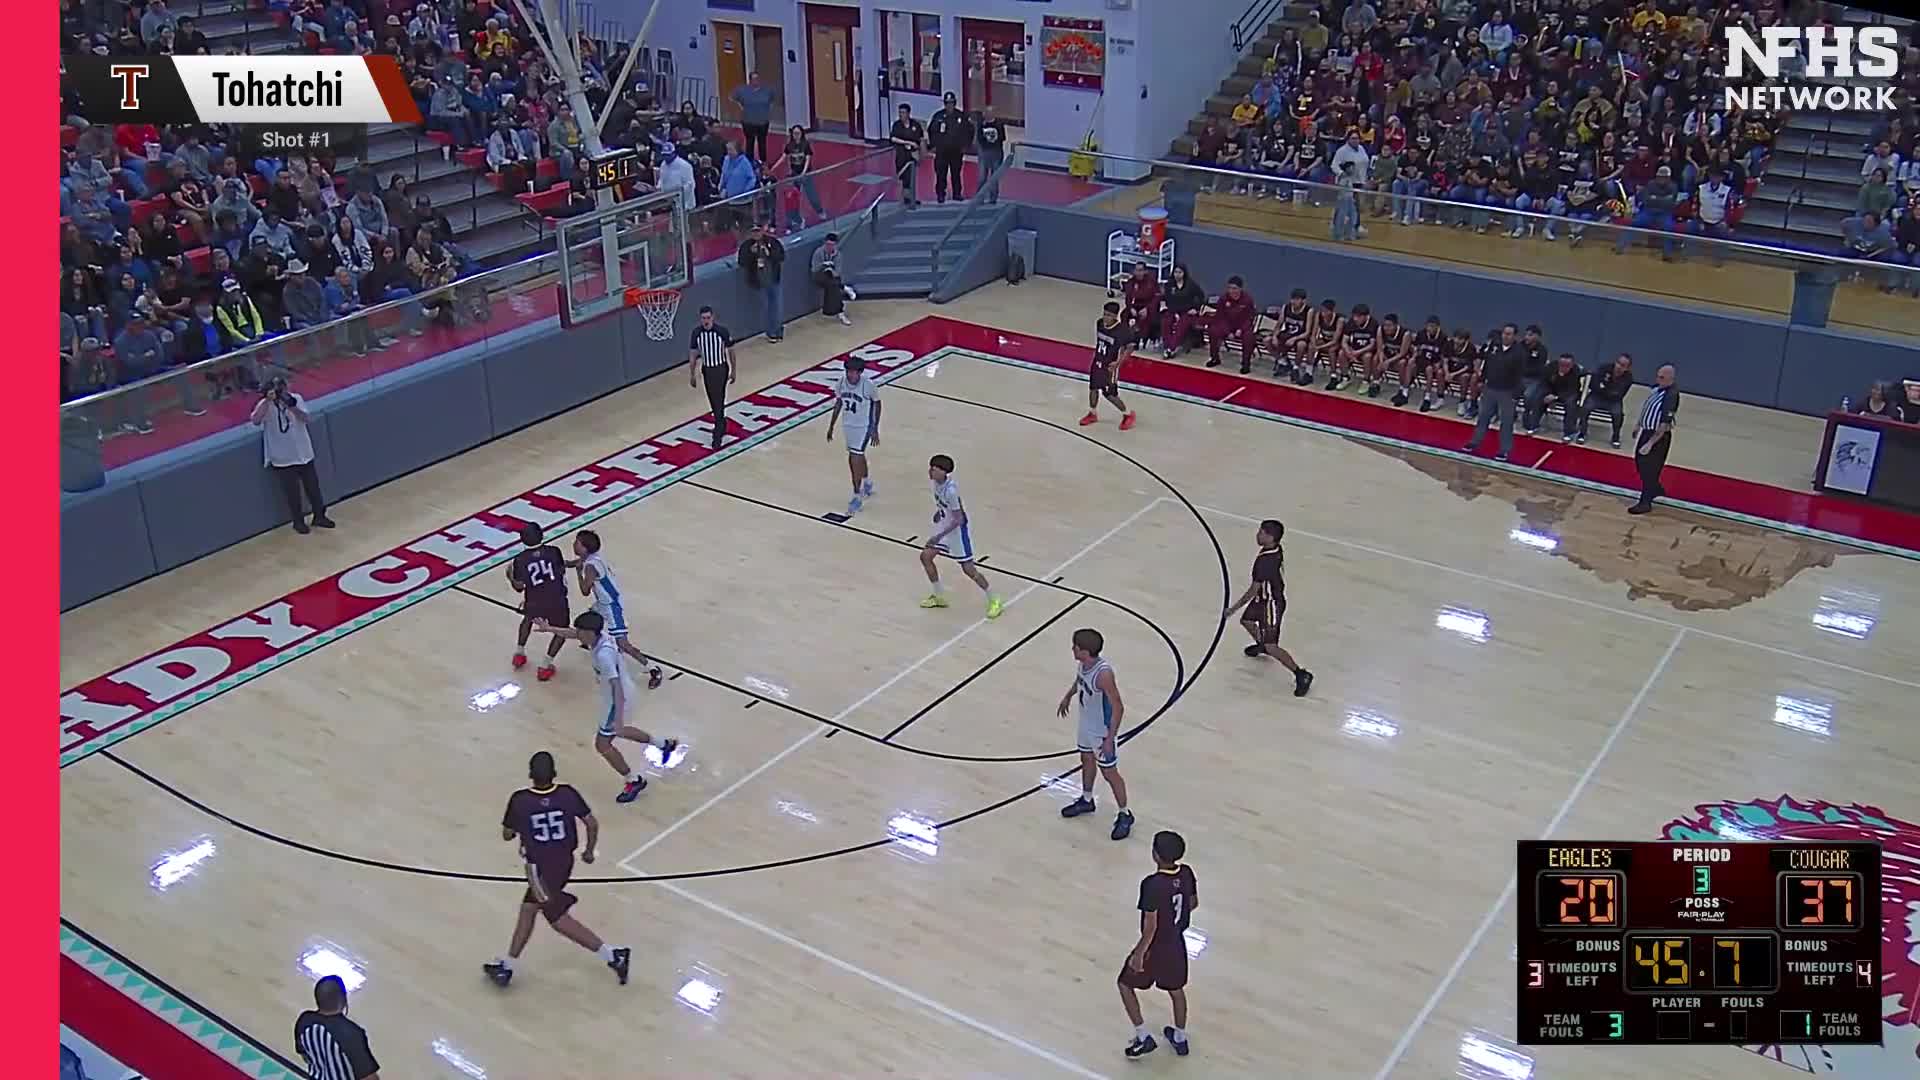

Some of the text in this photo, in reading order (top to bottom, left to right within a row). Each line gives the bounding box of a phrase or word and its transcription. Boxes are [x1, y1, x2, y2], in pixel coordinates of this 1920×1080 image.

[599, 163, 616, 181] 45
[1142, 224, 1152, 236] G
[844, 400, 856, 414] 34
[527, 560, 554, 586] 24
[531, 810, 566, 841] 55
